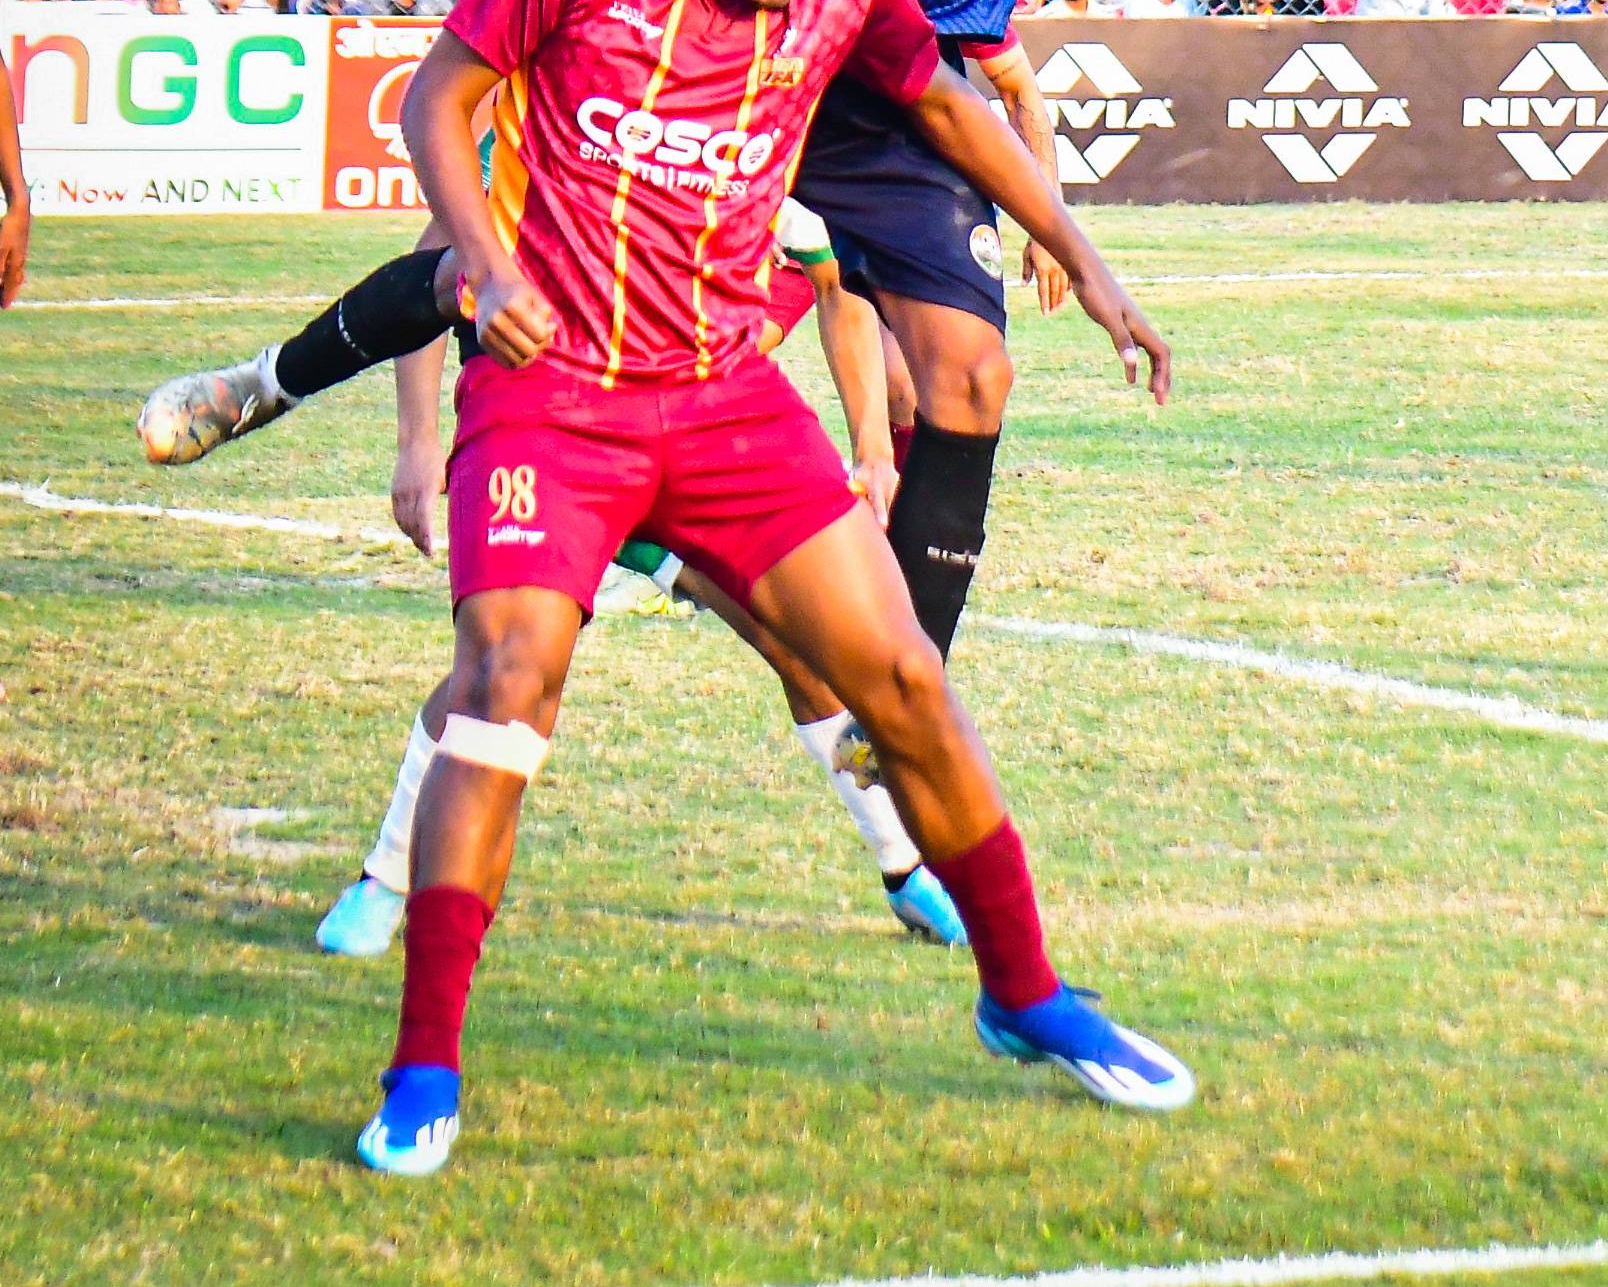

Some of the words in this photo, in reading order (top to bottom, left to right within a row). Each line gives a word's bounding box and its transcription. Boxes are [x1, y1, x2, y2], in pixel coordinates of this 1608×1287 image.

[1227, 97, 1411, 128] NIVIA
[577, 97, 775, 176] COSCO
[141, 178, 209, 203] AND
[222, 177, 302, 203] NEXT
[335, 166, 429, 208] on
[488, 464, 536, 523] 98
